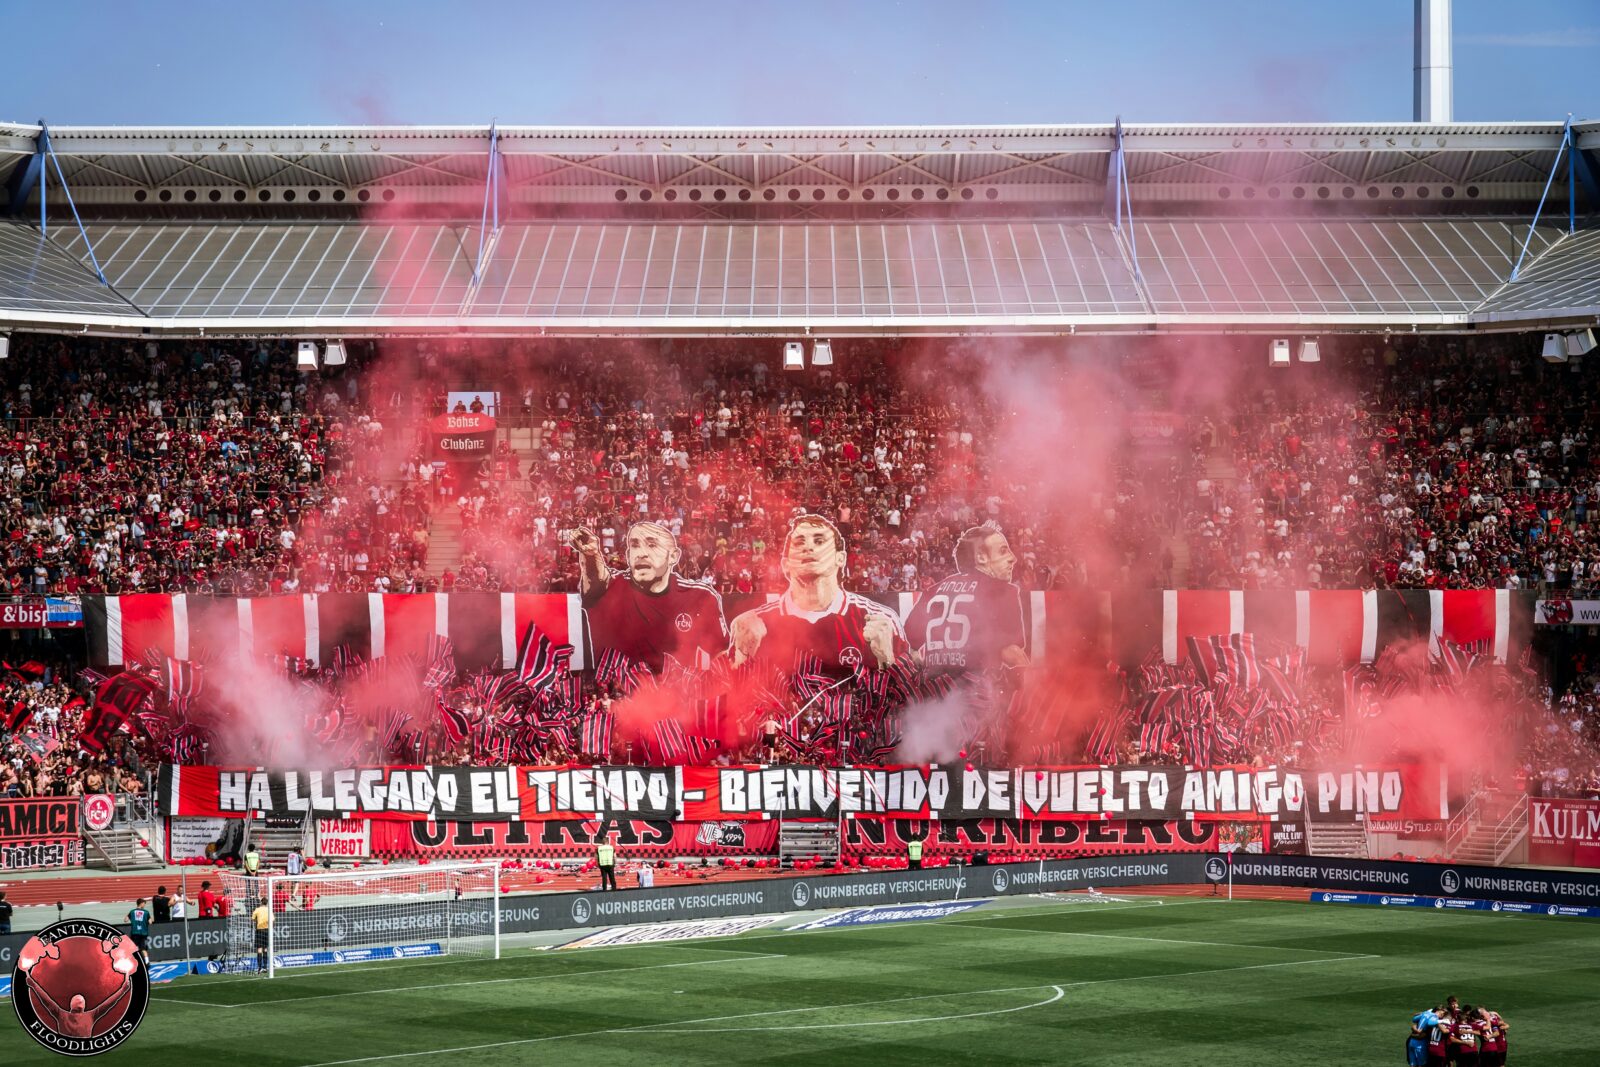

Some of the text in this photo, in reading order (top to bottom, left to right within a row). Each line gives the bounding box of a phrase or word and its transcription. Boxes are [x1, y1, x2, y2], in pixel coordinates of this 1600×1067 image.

[936, 581, 978, 593] PINOLA
[3, 606, 16, 622] &
[926, 594, 975, 651] 25
[220, 771, 273, 811] HA
[285, 769, 458, 812] LLEGADO
[470, 771, 519, 813] EL
[528, 769, 669, 812] TIEMPO
[720, 769, 949, 813] BIENVENIDO
[962, 770, 1010, 810] DE
[1181, 769, 1303, 812] AMIGO
[1318, 771, 1401, 812] PINO
[0, 804, 77, 836] AMICI
[90, 809, 107, 820] FCN
[320, 818, 364, 833] STADION
[1281, 824, 1296, 832] YOU
[320, 838, 364, 855] VERBOT
[725, 833, 743, 843] 1994
[1012, 863, 1169, 886] NÜRNBERGER VERSICHERUNG
[1232, 863, 1409, 885] NÜRNBERGER VERSICHERUNG
[813, 877, 967, 900] NÜRNBERGER VERSICHERUNG
[1464, 876, 1548, 894] NÜRNBERGER
[596, 891, 764, 916] NÜRNBERGER VERSICHERUNG
